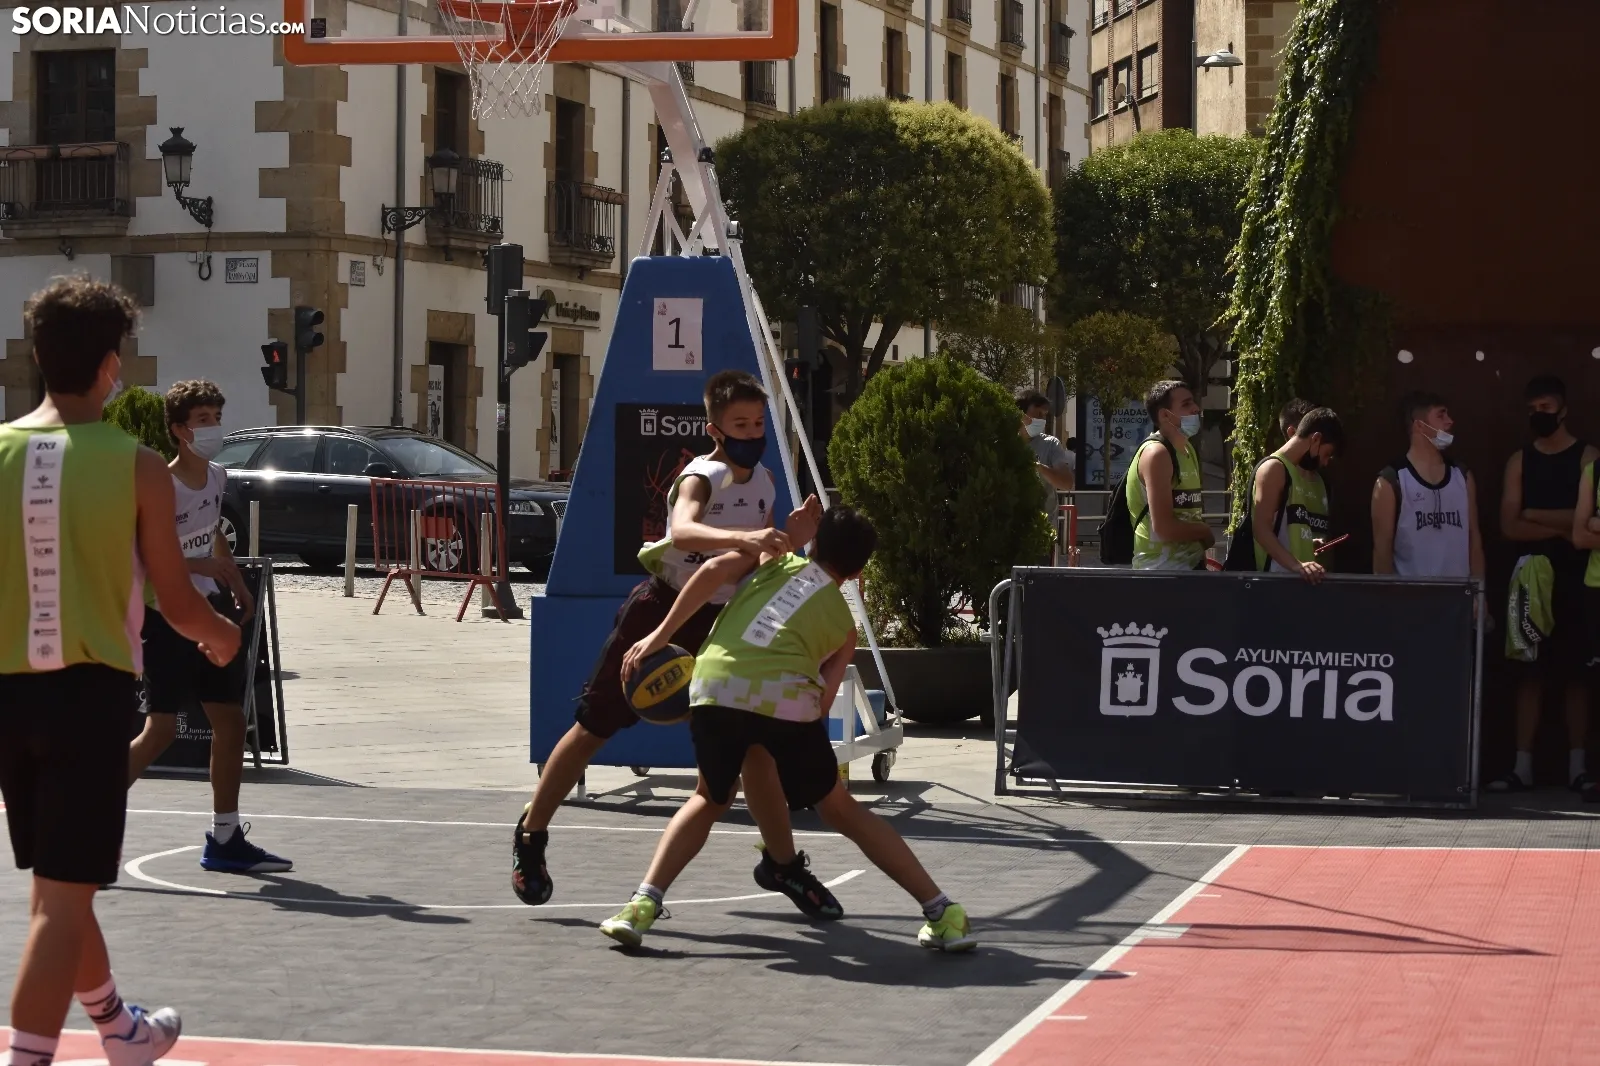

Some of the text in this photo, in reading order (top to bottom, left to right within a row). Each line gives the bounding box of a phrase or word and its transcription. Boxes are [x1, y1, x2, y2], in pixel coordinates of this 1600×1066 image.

[667, 317, 685, 349] 1
[660, 415, 707, 436] Sori
[1234, 648, 1394, 668] AYUNTAMIENTO
[1171, 647, 1394, 721] Soria
